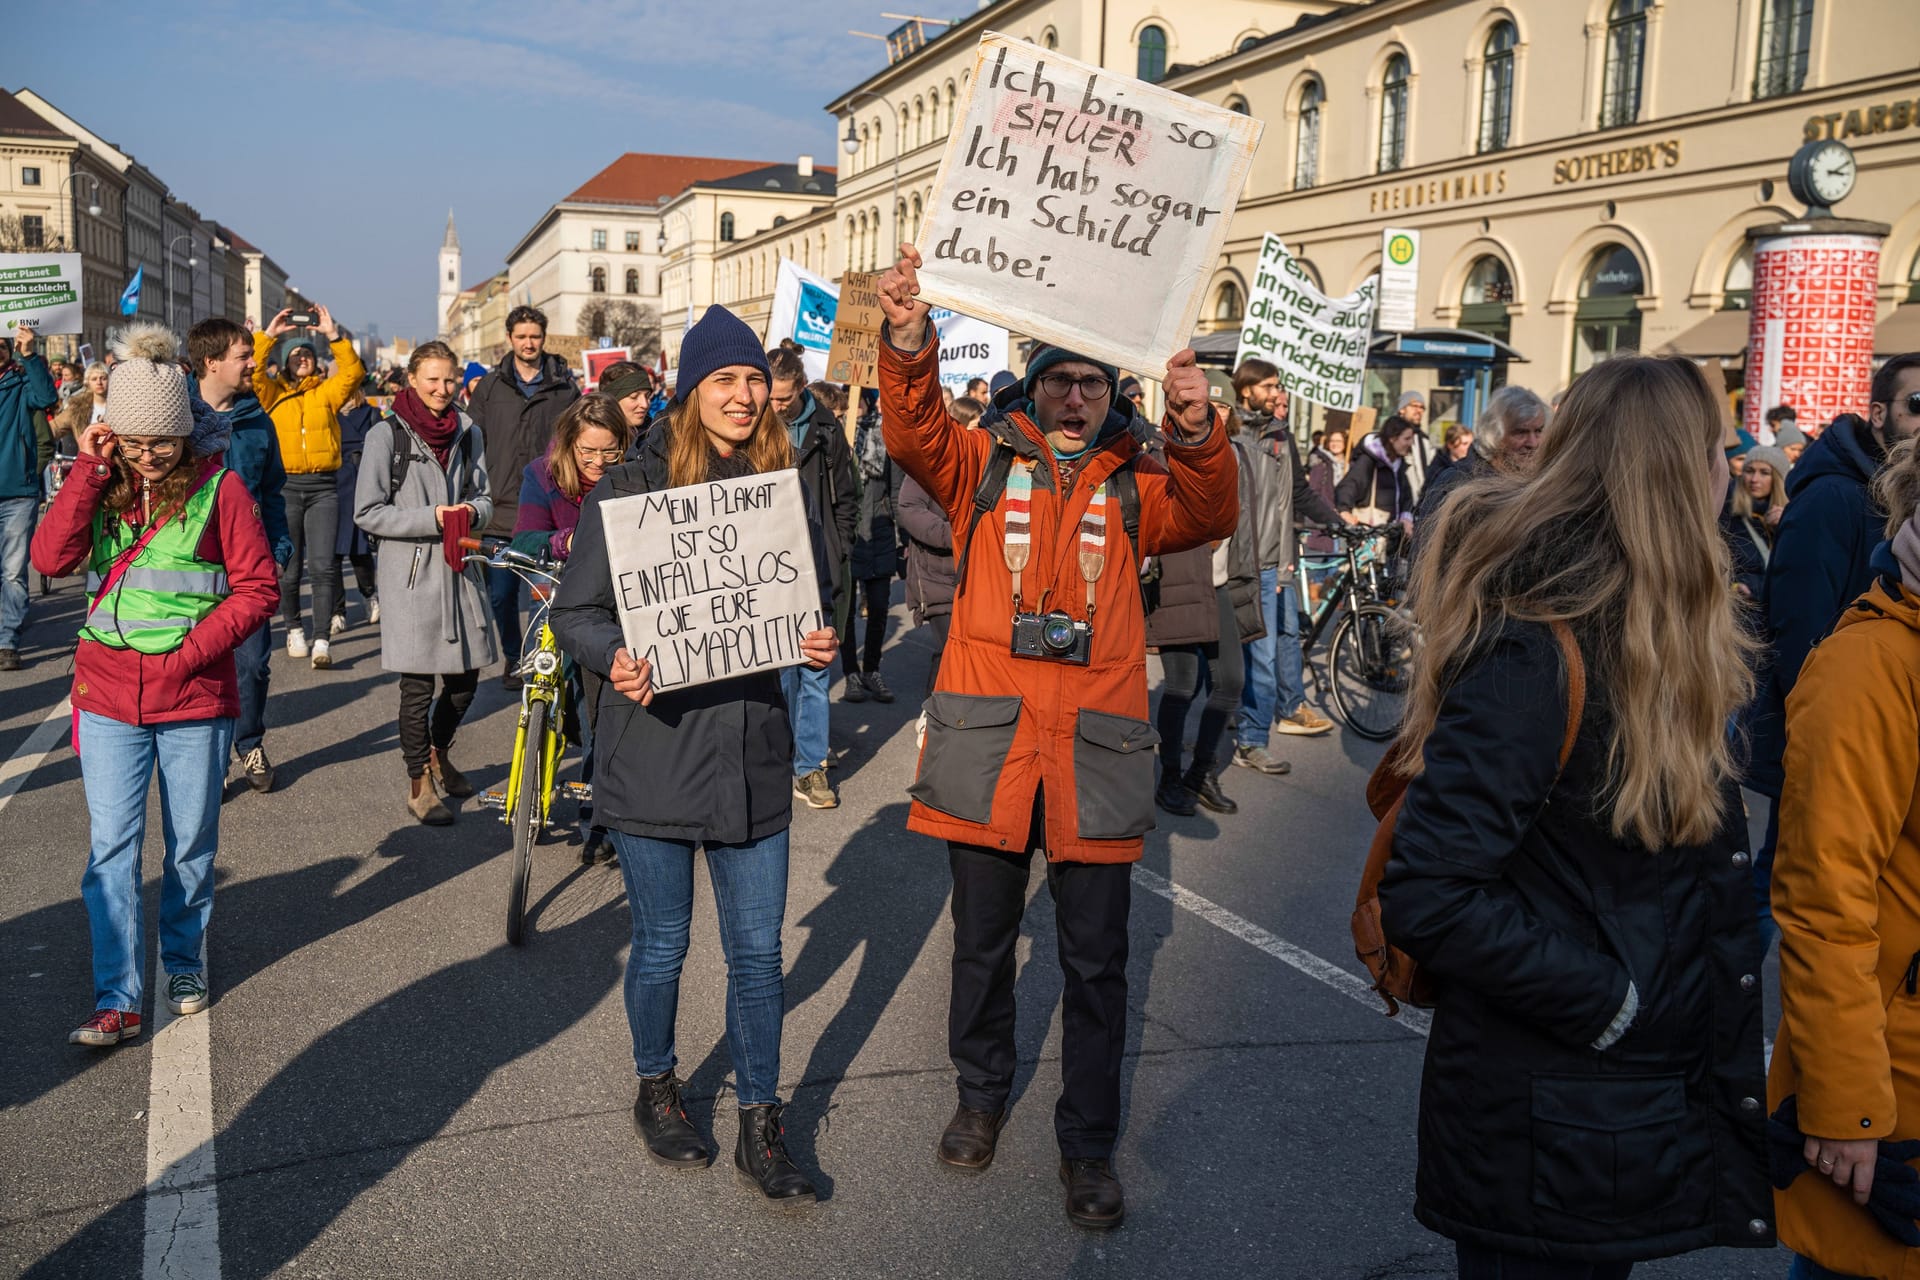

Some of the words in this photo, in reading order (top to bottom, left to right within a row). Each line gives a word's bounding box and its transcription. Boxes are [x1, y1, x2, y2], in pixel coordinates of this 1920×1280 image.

[989, 47, 1056, 103] Ich
[1079, 73, 1144, 131] bin
[1168, 122, 1218, 150] so
[1008, 102, 1138, 166] SAUER
[1803, 97, 1920, 145] STARB
[965, 125, 1017, 177] Ich
[1036, 145, 1100, 196] hab
[1111, 183, 1221, 227] sogar
[1553, 139, 1680, 185] SOTHEBY'S
[1370, 170, 1506, 213] FREUDENHAUS
[952, 187, 1010, 219] ein
[1030, 195, 1161, 257] Schild
[4, 284, 27, 293] auch
[29, 282, 67, 292] schlecht
[20, 267, 50, 278] Planet
[847, 272, 872, 289] WHAT
[8, 300, 23, 310] die
[24, 293, 72, 307] Wirtschaft
[848, 290, 879, 308] STAND
[1250, 297, 1286, 327] die
[859, 312, 869, 327] IS
[837, 328, 863, 346] WHAT
[940, 343, 990, 362] AUTOS
[1243, 324, 1280, 353] der
[848, 347, 876, 363] STAND
[638, 493, 698, 530] MEIN
[709, 482, 777, 516] PLAKAT
[670, 530, 704, 560] IST
[708, 524, 738, 554] SO
[618, 551, 799, 611] EINFALLSLOS
[656, 604, 697, 638] WIE
[711, 588, 760, 624] EURE
